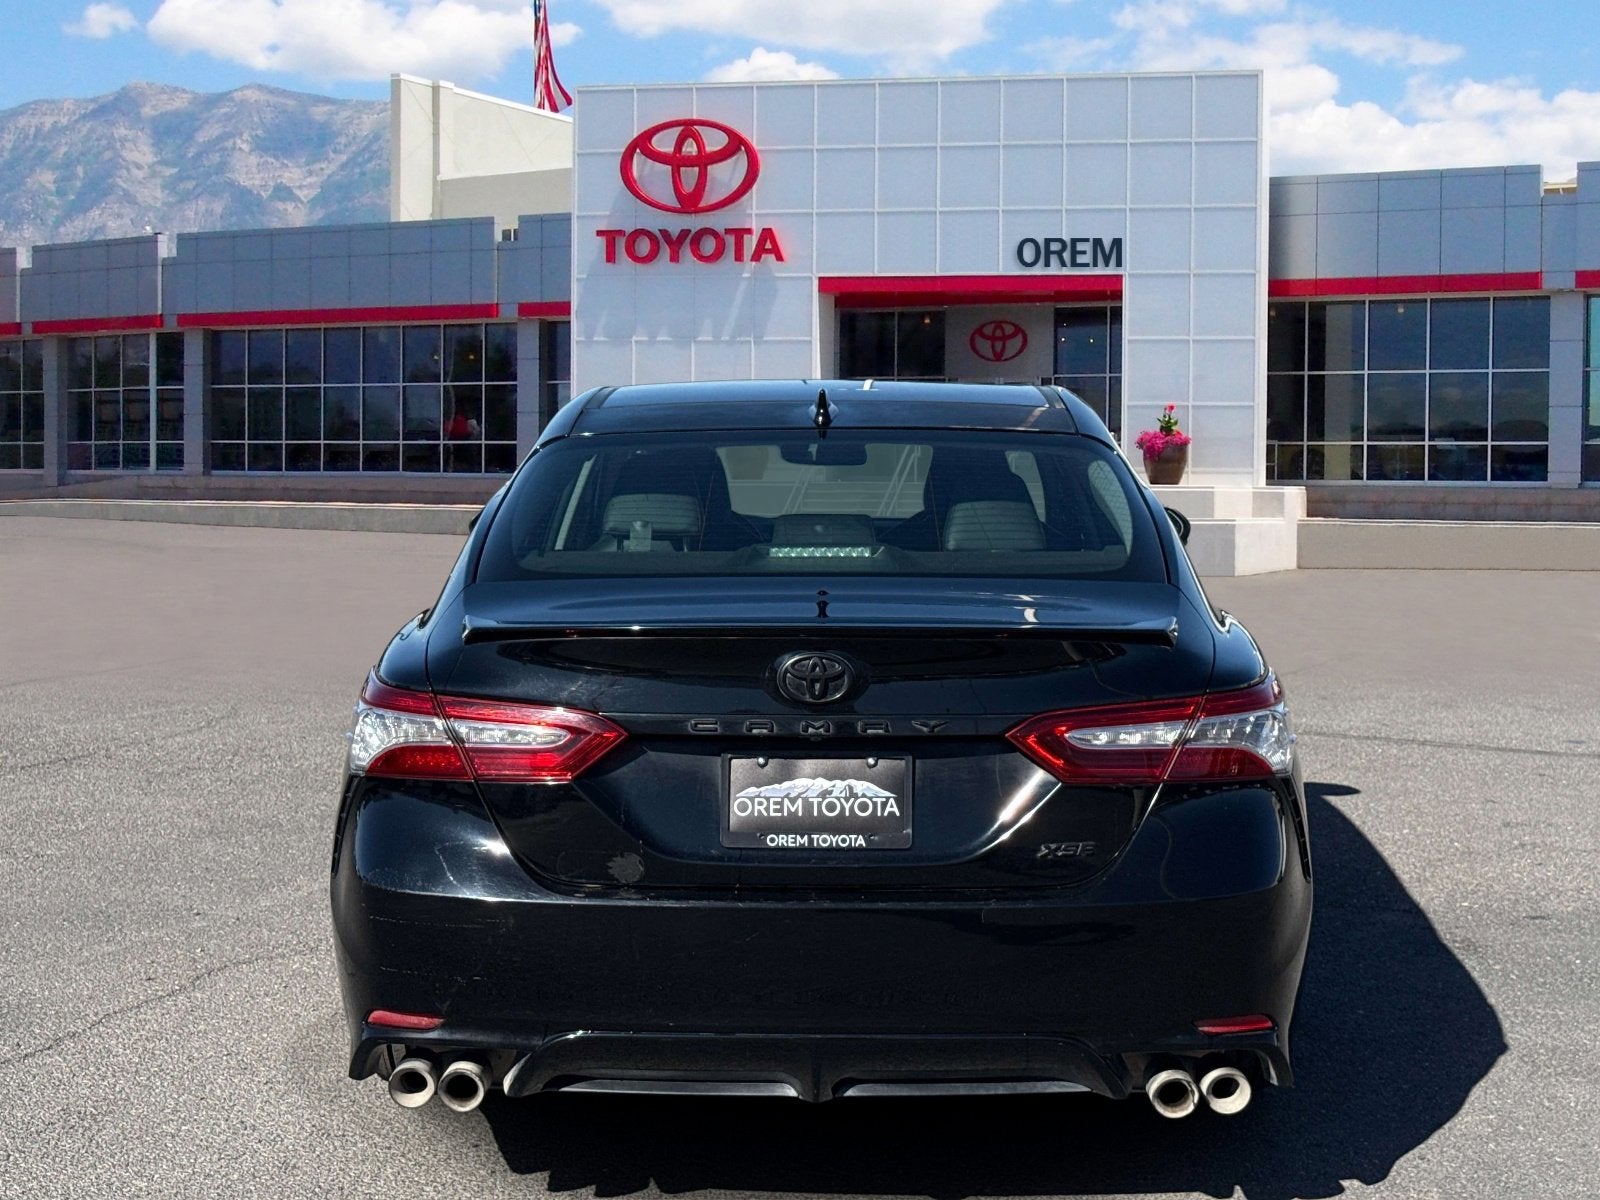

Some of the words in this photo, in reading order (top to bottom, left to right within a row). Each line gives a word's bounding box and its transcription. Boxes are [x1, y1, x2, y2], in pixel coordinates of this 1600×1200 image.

[596, 227, 785, 265] TOYOTA
[1016, 237, 1124, 268] OREM
[733, 797, 803, 817] OREM
[809, 797, 900, 817] TOYOTA
[766, 834, 808, 847] OREM
[811, 834, 866, 847] TOYOTA
[1036, 841, 1096, 858] XSE
